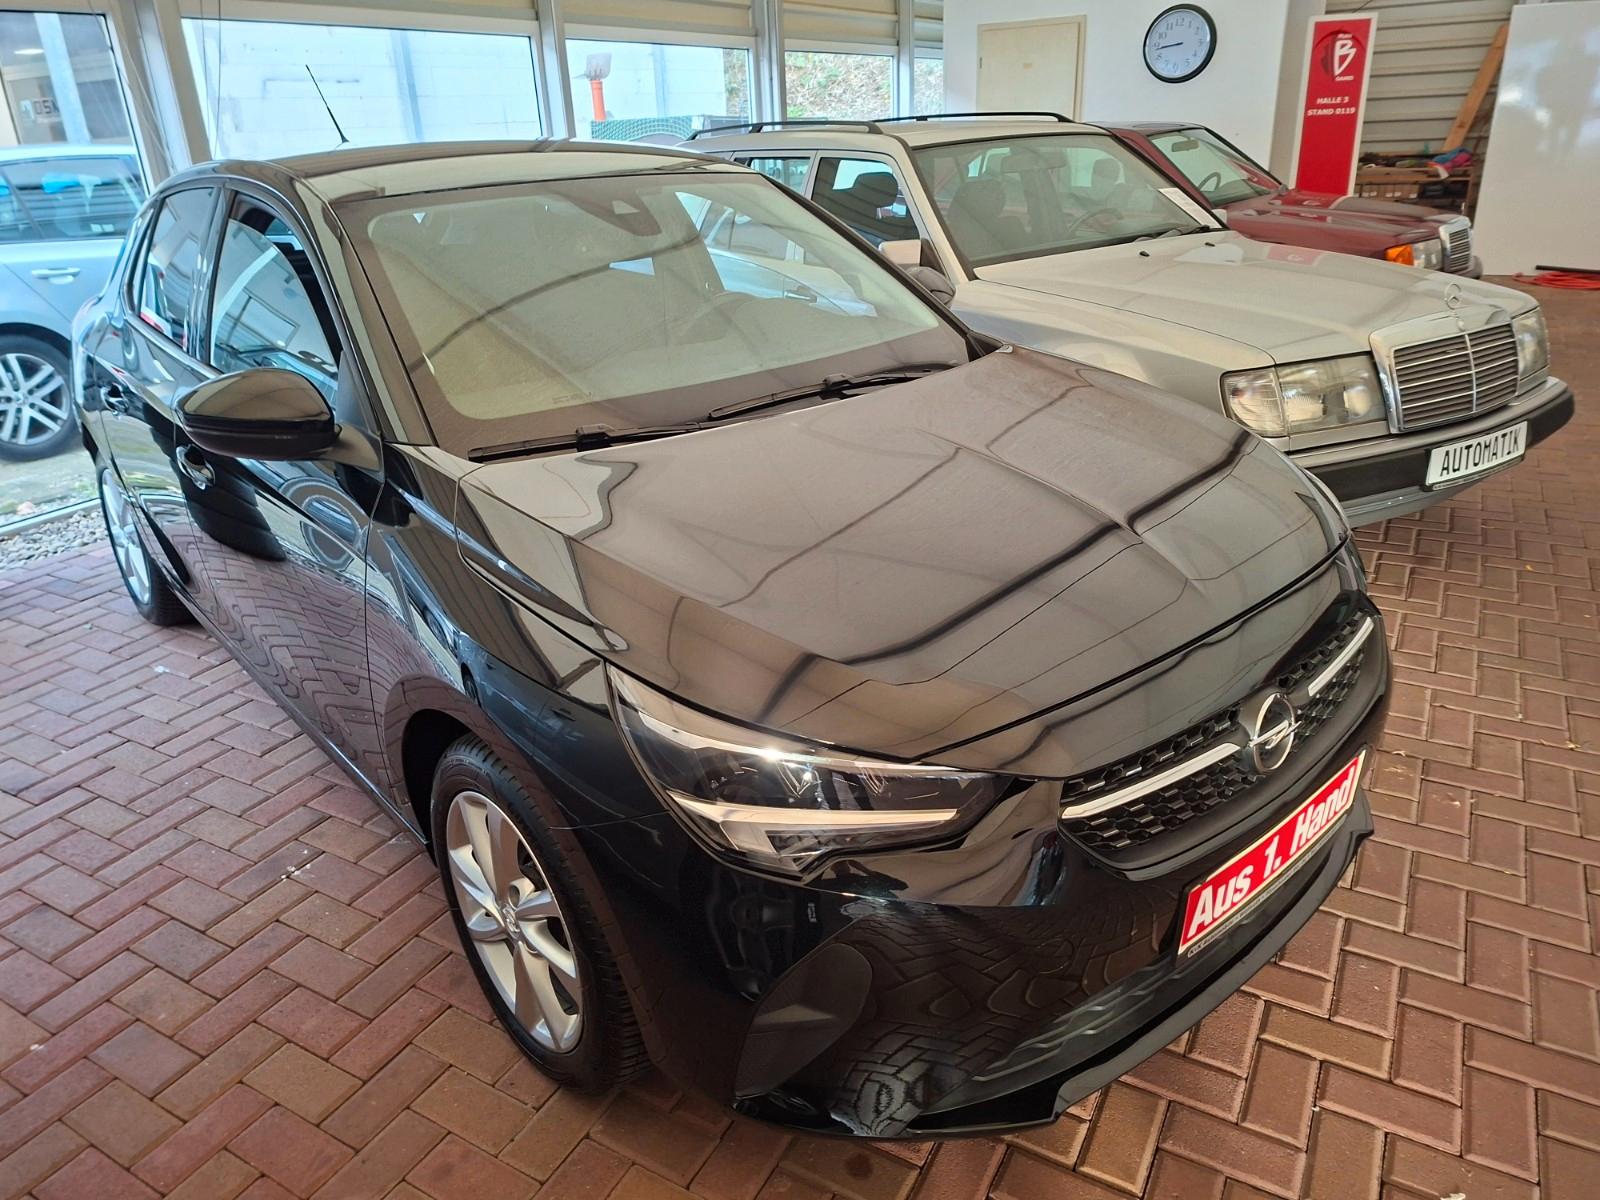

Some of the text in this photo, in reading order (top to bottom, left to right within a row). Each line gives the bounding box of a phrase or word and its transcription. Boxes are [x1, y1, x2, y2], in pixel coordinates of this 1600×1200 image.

[1166, 22, 1174, 31] 11
[1175, 17, 1185, 27] 12
[1158, 32, 1167, 40] 10
[1316, 96, 1350, 105] HALLE 3
[1307, 107, 1356, 116] STAND 0119
[1440, 427, 1521, 477] AUTOMATIK
[1187, 865, 1254, 938] Aus
[1263, 835, 1282, 879] 1.
[1290, 764, 1355, 855] Hand
